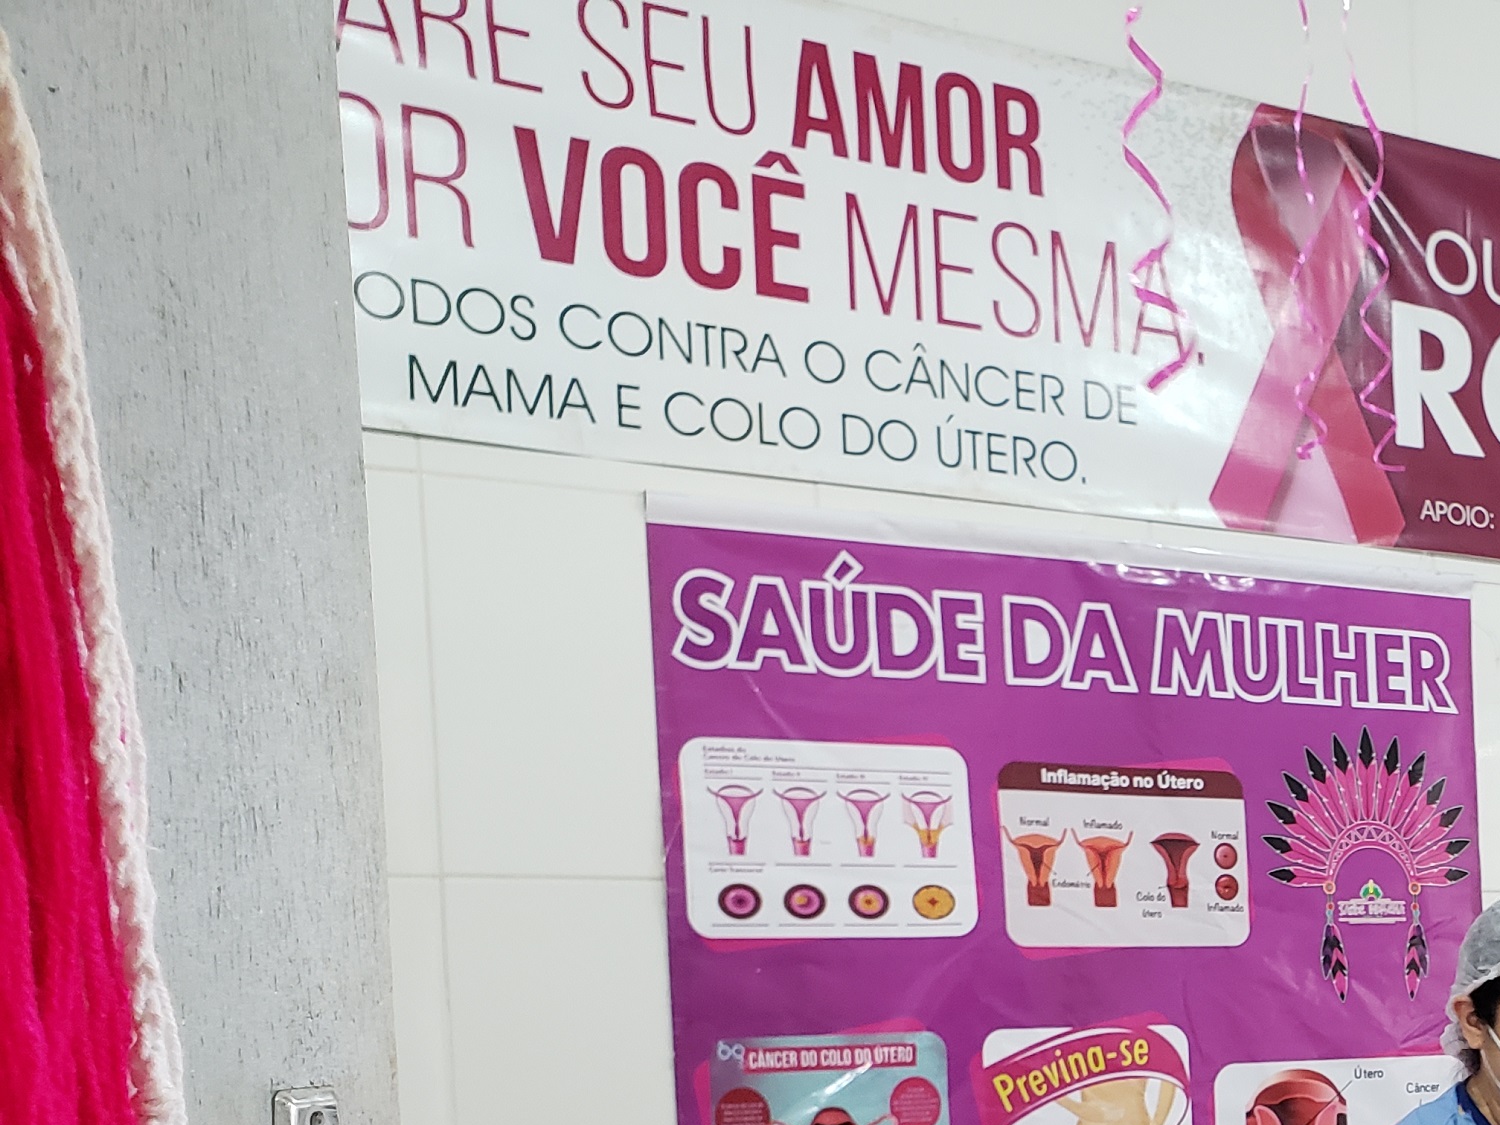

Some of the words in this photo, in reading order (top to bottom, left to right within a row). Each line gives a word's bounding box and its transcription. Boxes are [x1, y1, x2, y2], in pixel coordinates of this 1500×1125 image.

[577, 0, 756, 136] SEU
[791, 38, 1044, 197] AMOR
[513, 124, 809, 305] VOCÊ
[845, 192, 1204, 366] MESMA.
[353, 270, 536, 341] ODOS
[560, 304, 787, 378] CONTRA
[805, 340, 845, 384] O
[865, 343, 1065, 416] CÂNCER
[1084, 380, 1138, 426] DE
[407, 354, 596, 424] MAMA
[620, 385, 642, 430] E
[664, 389, 820, 451] COLO
[842, 413, 917, 461] DO
[937, 414, 1086, 484] ÚTERO.
[1420, 500, 1495, 530] APOIO:
[672, 550, 987, 684] SAÚDE
[1002, 594, 1140, 694] DA
[1151, 607, 1458, 715] MULHER
[1041, 767, 1129, 790] Inflamação
[1133, 775, 1153, 788] no
[1157, 770, 1205, 790] Útero
[1211, 830, 1239, 840] Normal
[992, 1038, 1149, 1113] Previna-se
[1354, 1065, 1384, 1080] Útero
[1406, 1082, 1440, 1094] Câncer
